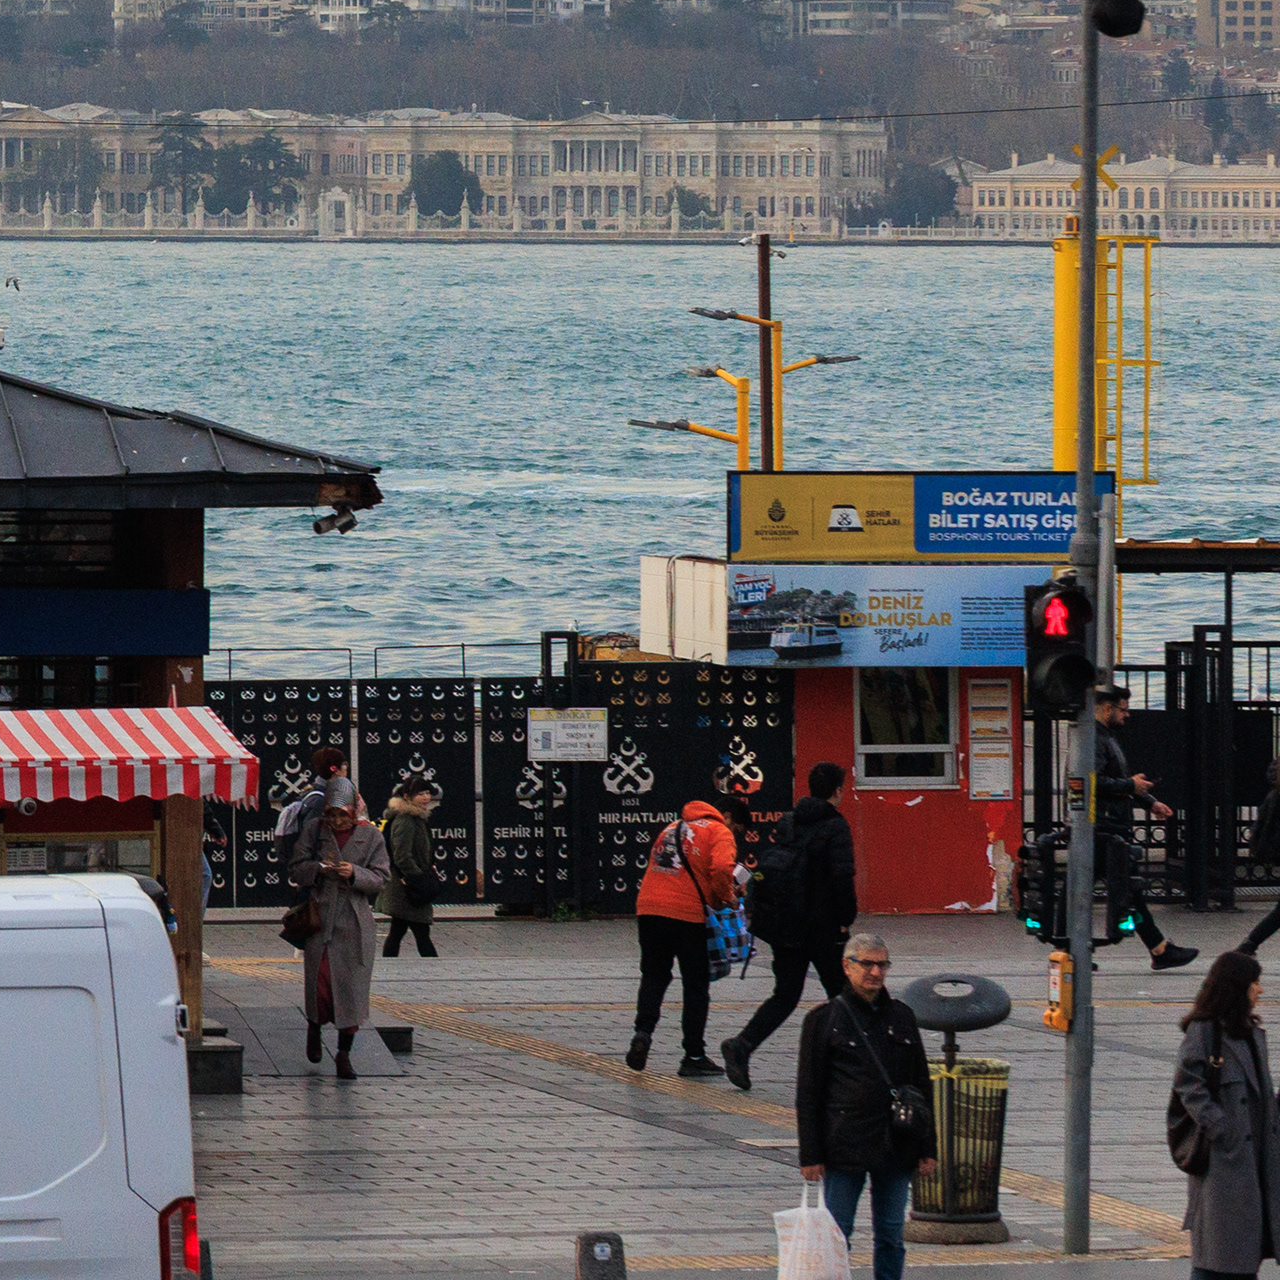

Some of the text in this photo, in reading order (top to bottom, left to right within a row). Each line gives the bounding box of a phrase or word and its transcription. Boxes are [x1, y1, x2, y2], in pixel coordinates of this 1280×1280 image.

[942, 488, 1007, 506] BOĞAZ
[929, 510, 979, 528] BİLET
[984, 514, 1038, 531] SATIŞ
[929, 533, 993, 541] BOSPHORUS
[996, 533, 1030, 541] TOURS
[1033, 533, 1067, 541] TICKET
[868, 593, 924, 610] DENİZ
[840, 612, 953, 630] DOLMUŞLAR
[622, 812, 678, 823] HATLARI
[493, 824, 531, 840] ŞEHİR
